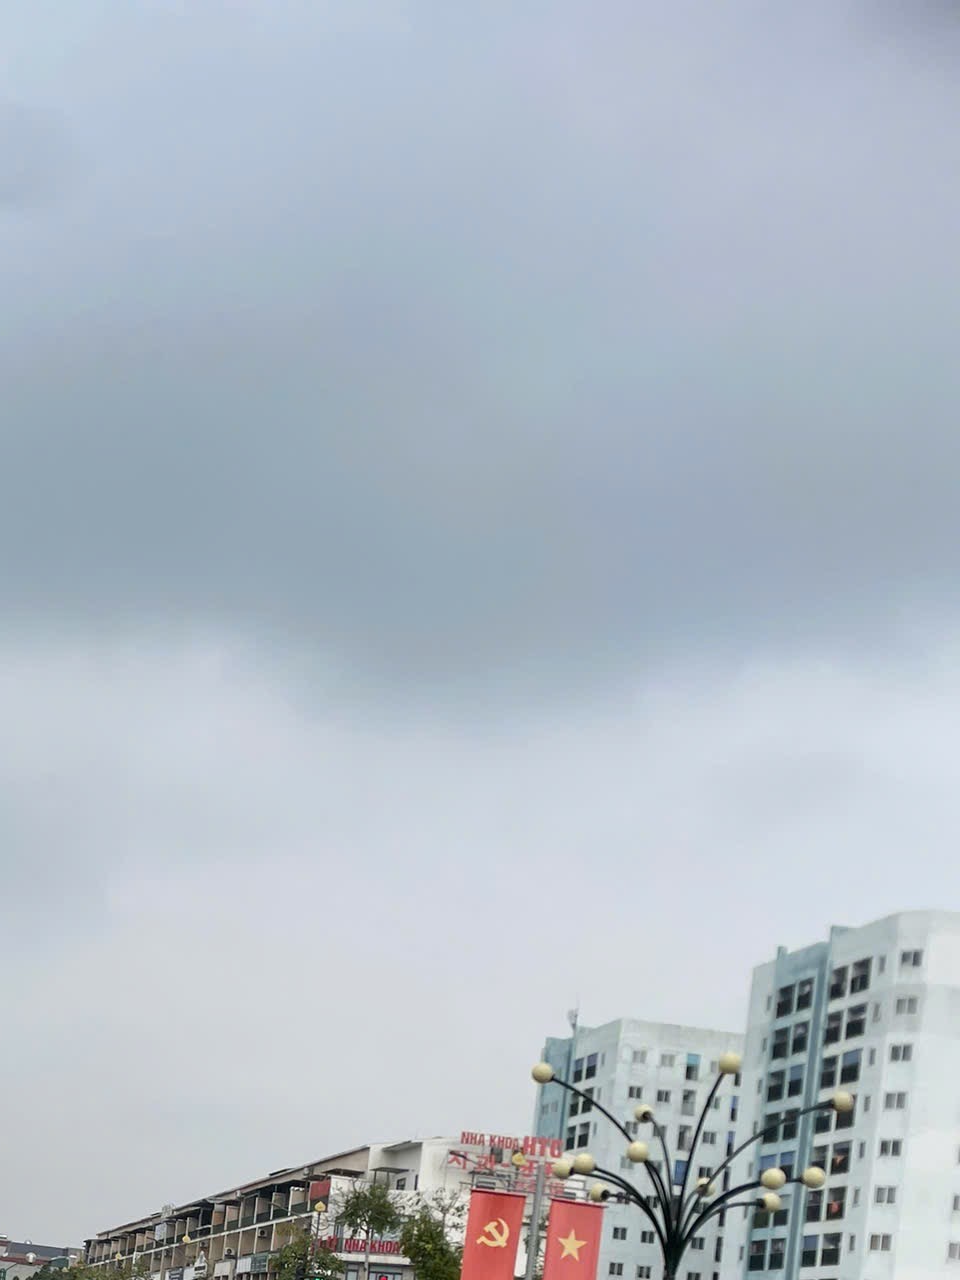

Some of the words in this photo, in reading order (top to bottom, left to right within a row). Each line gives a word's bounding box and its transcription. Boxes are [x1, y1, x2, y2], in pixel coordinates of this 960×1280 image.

[460, 1131, 485, 1145] NHA
[489, 1134, 520, 1150] KHOA
[344, 1238, 367, 1252] NHA
[369, 1240, 400, 1254] KHOA
